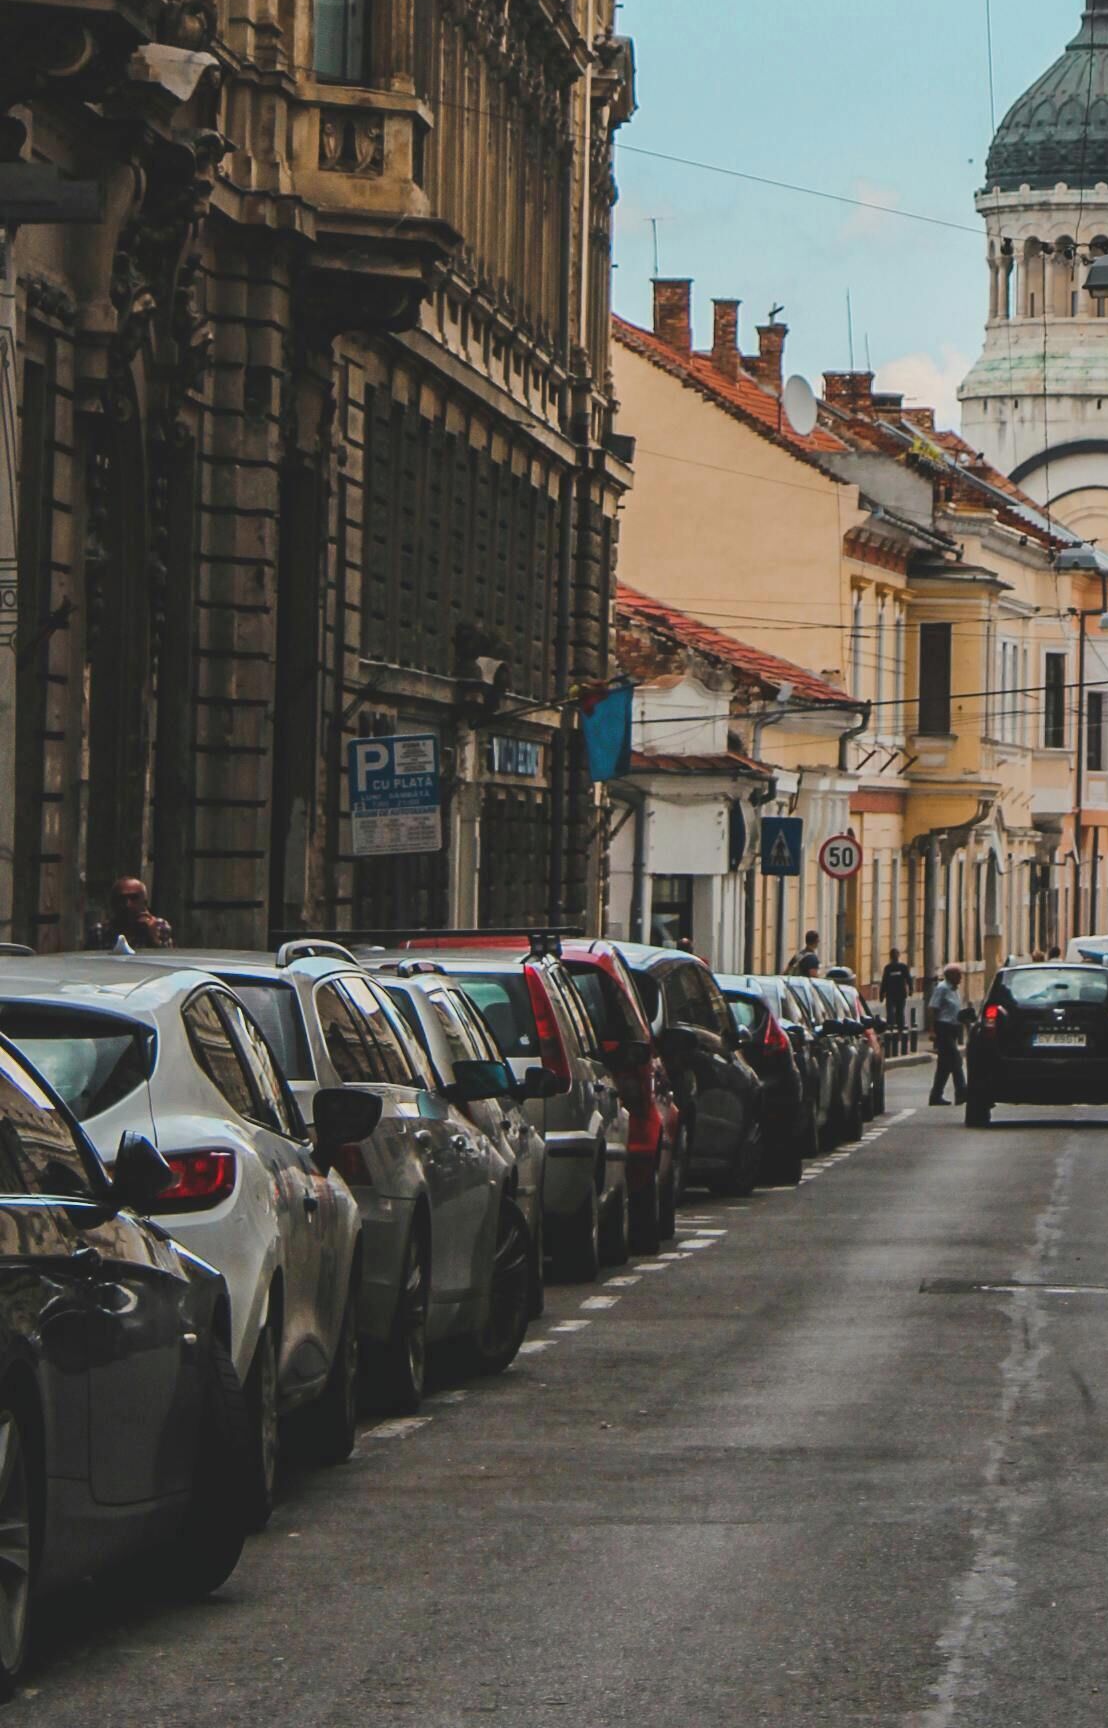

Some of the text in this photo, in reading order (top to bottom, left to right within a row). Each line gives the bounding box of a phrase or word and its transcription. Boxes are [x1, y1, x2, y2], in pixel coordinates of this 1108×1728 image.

[356, 743, 389, 792] P
[372, 779, 389, 790] CU
[829, 846, 853, 867] 50
